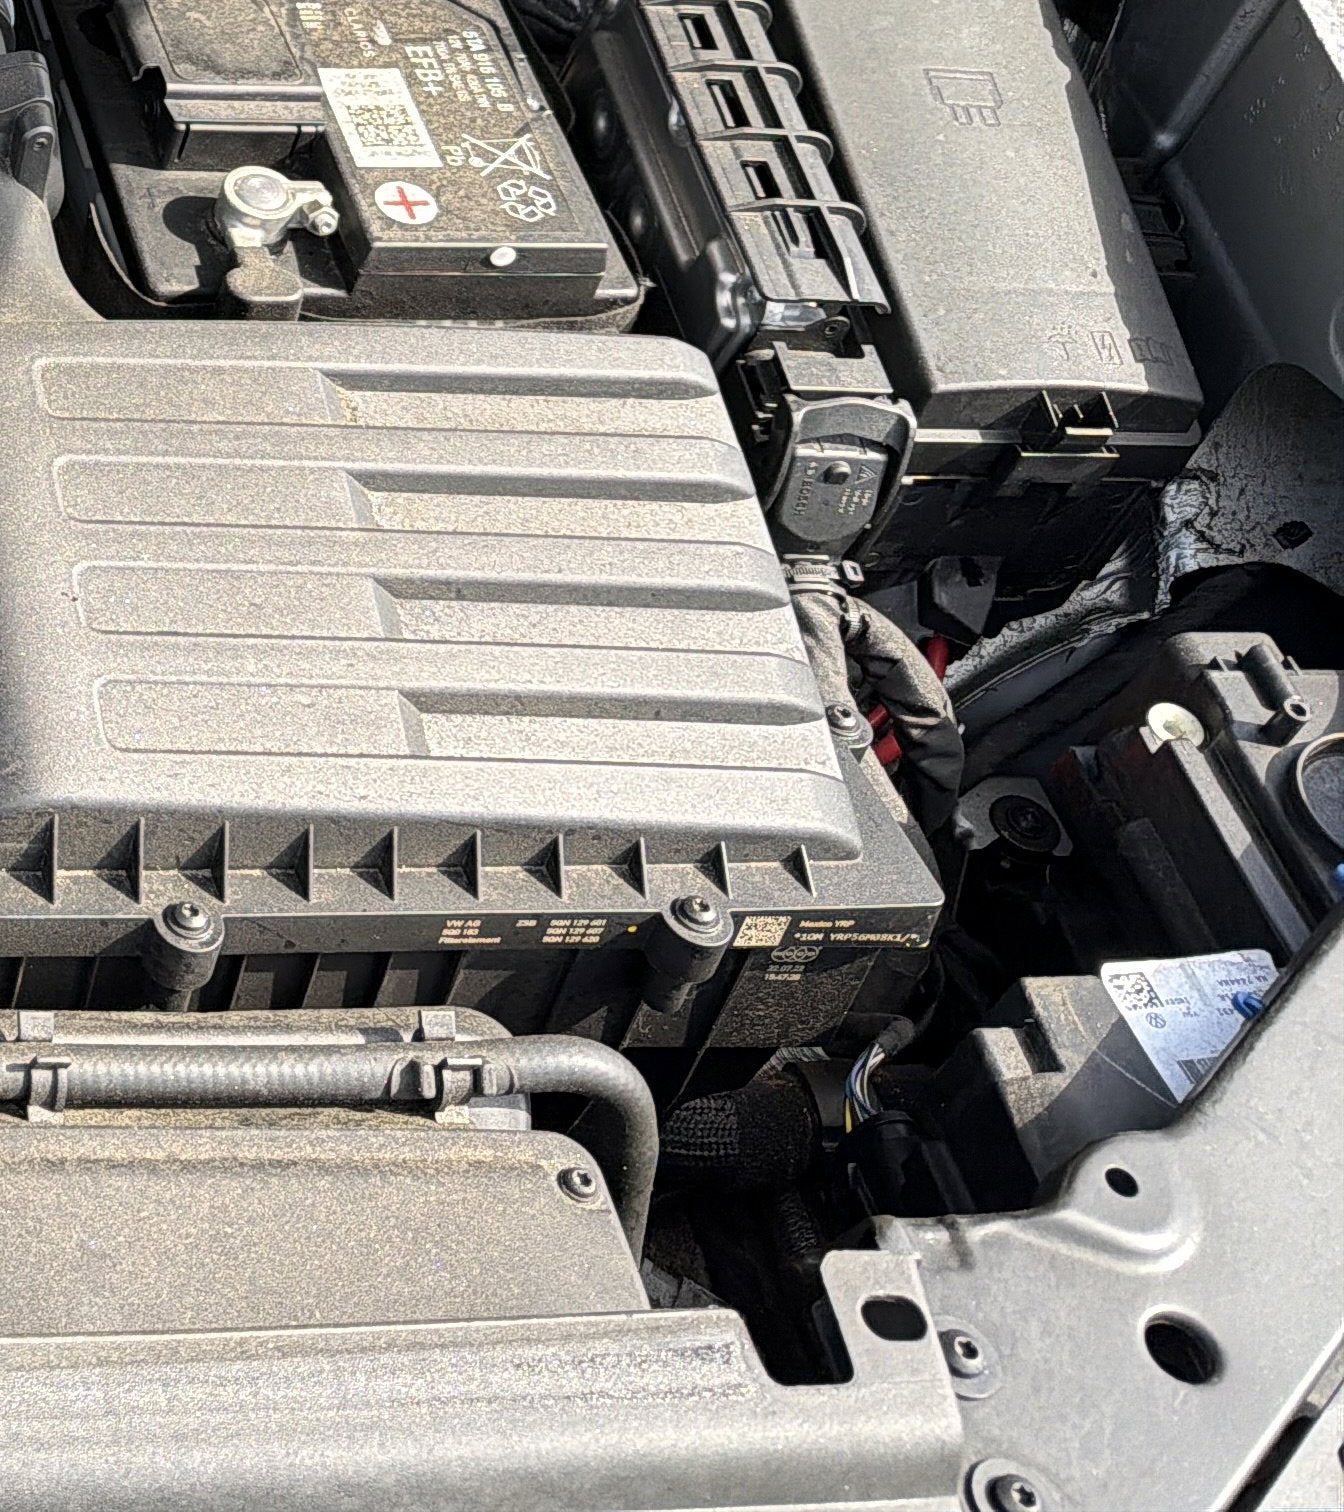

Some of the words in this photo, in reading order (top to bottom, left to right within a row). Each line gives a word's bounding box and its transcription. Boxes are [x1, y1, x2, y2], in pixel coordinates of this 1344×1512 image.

[344, 6, 375, 57] CLARIOS
[405, 46, 446, 95] EFB+
[442, 145, 463, 167] Pb
[446, 919, 464, 927] VW
[464, 919, 481, 927] AG
[834, 919, 856, 927] YRP
